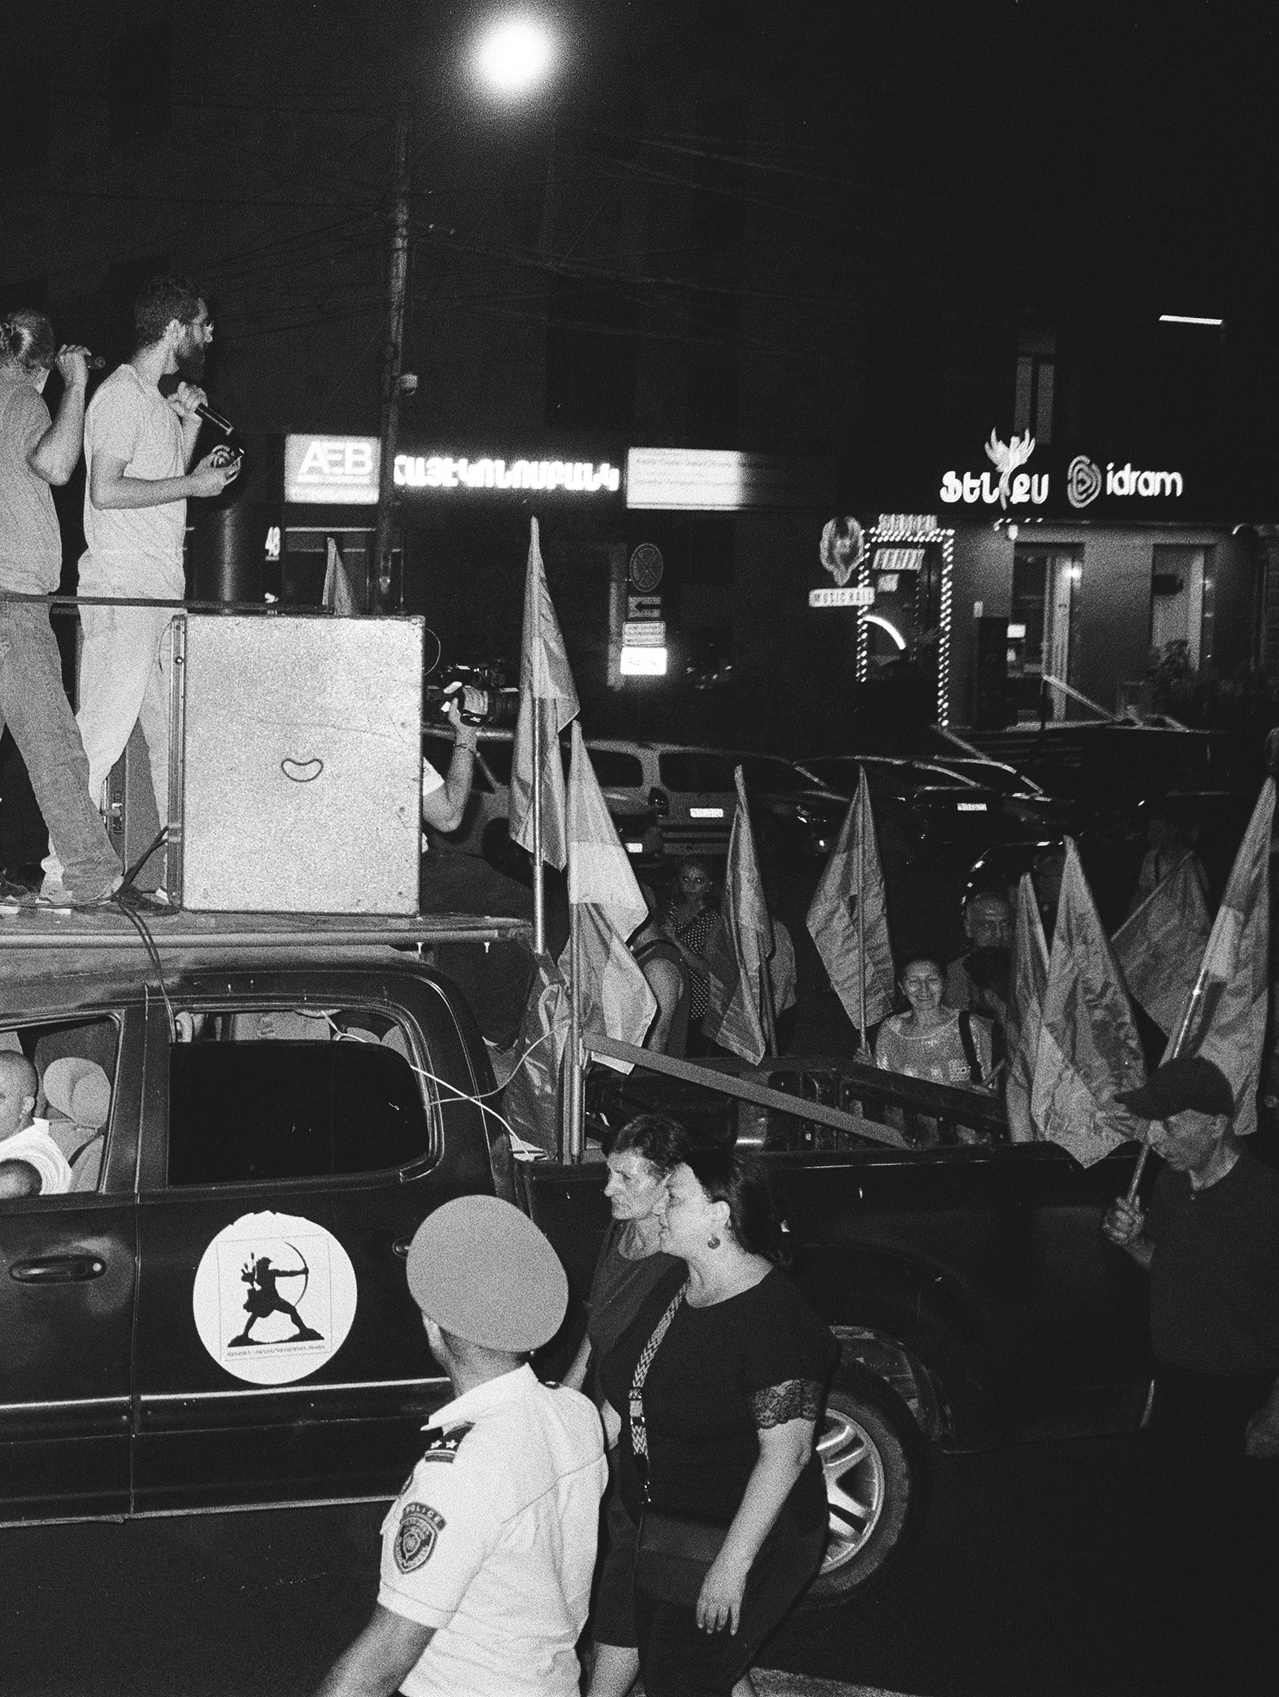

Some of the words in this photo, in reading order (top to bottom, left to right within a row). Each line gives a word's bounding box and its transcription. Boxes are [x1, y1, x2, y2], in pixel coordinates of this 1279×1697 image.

[299, 441, 373, 475] AEB
[1106, 463, 1183, 497] idram
[406, 1504, 441, 1524] POLICE
